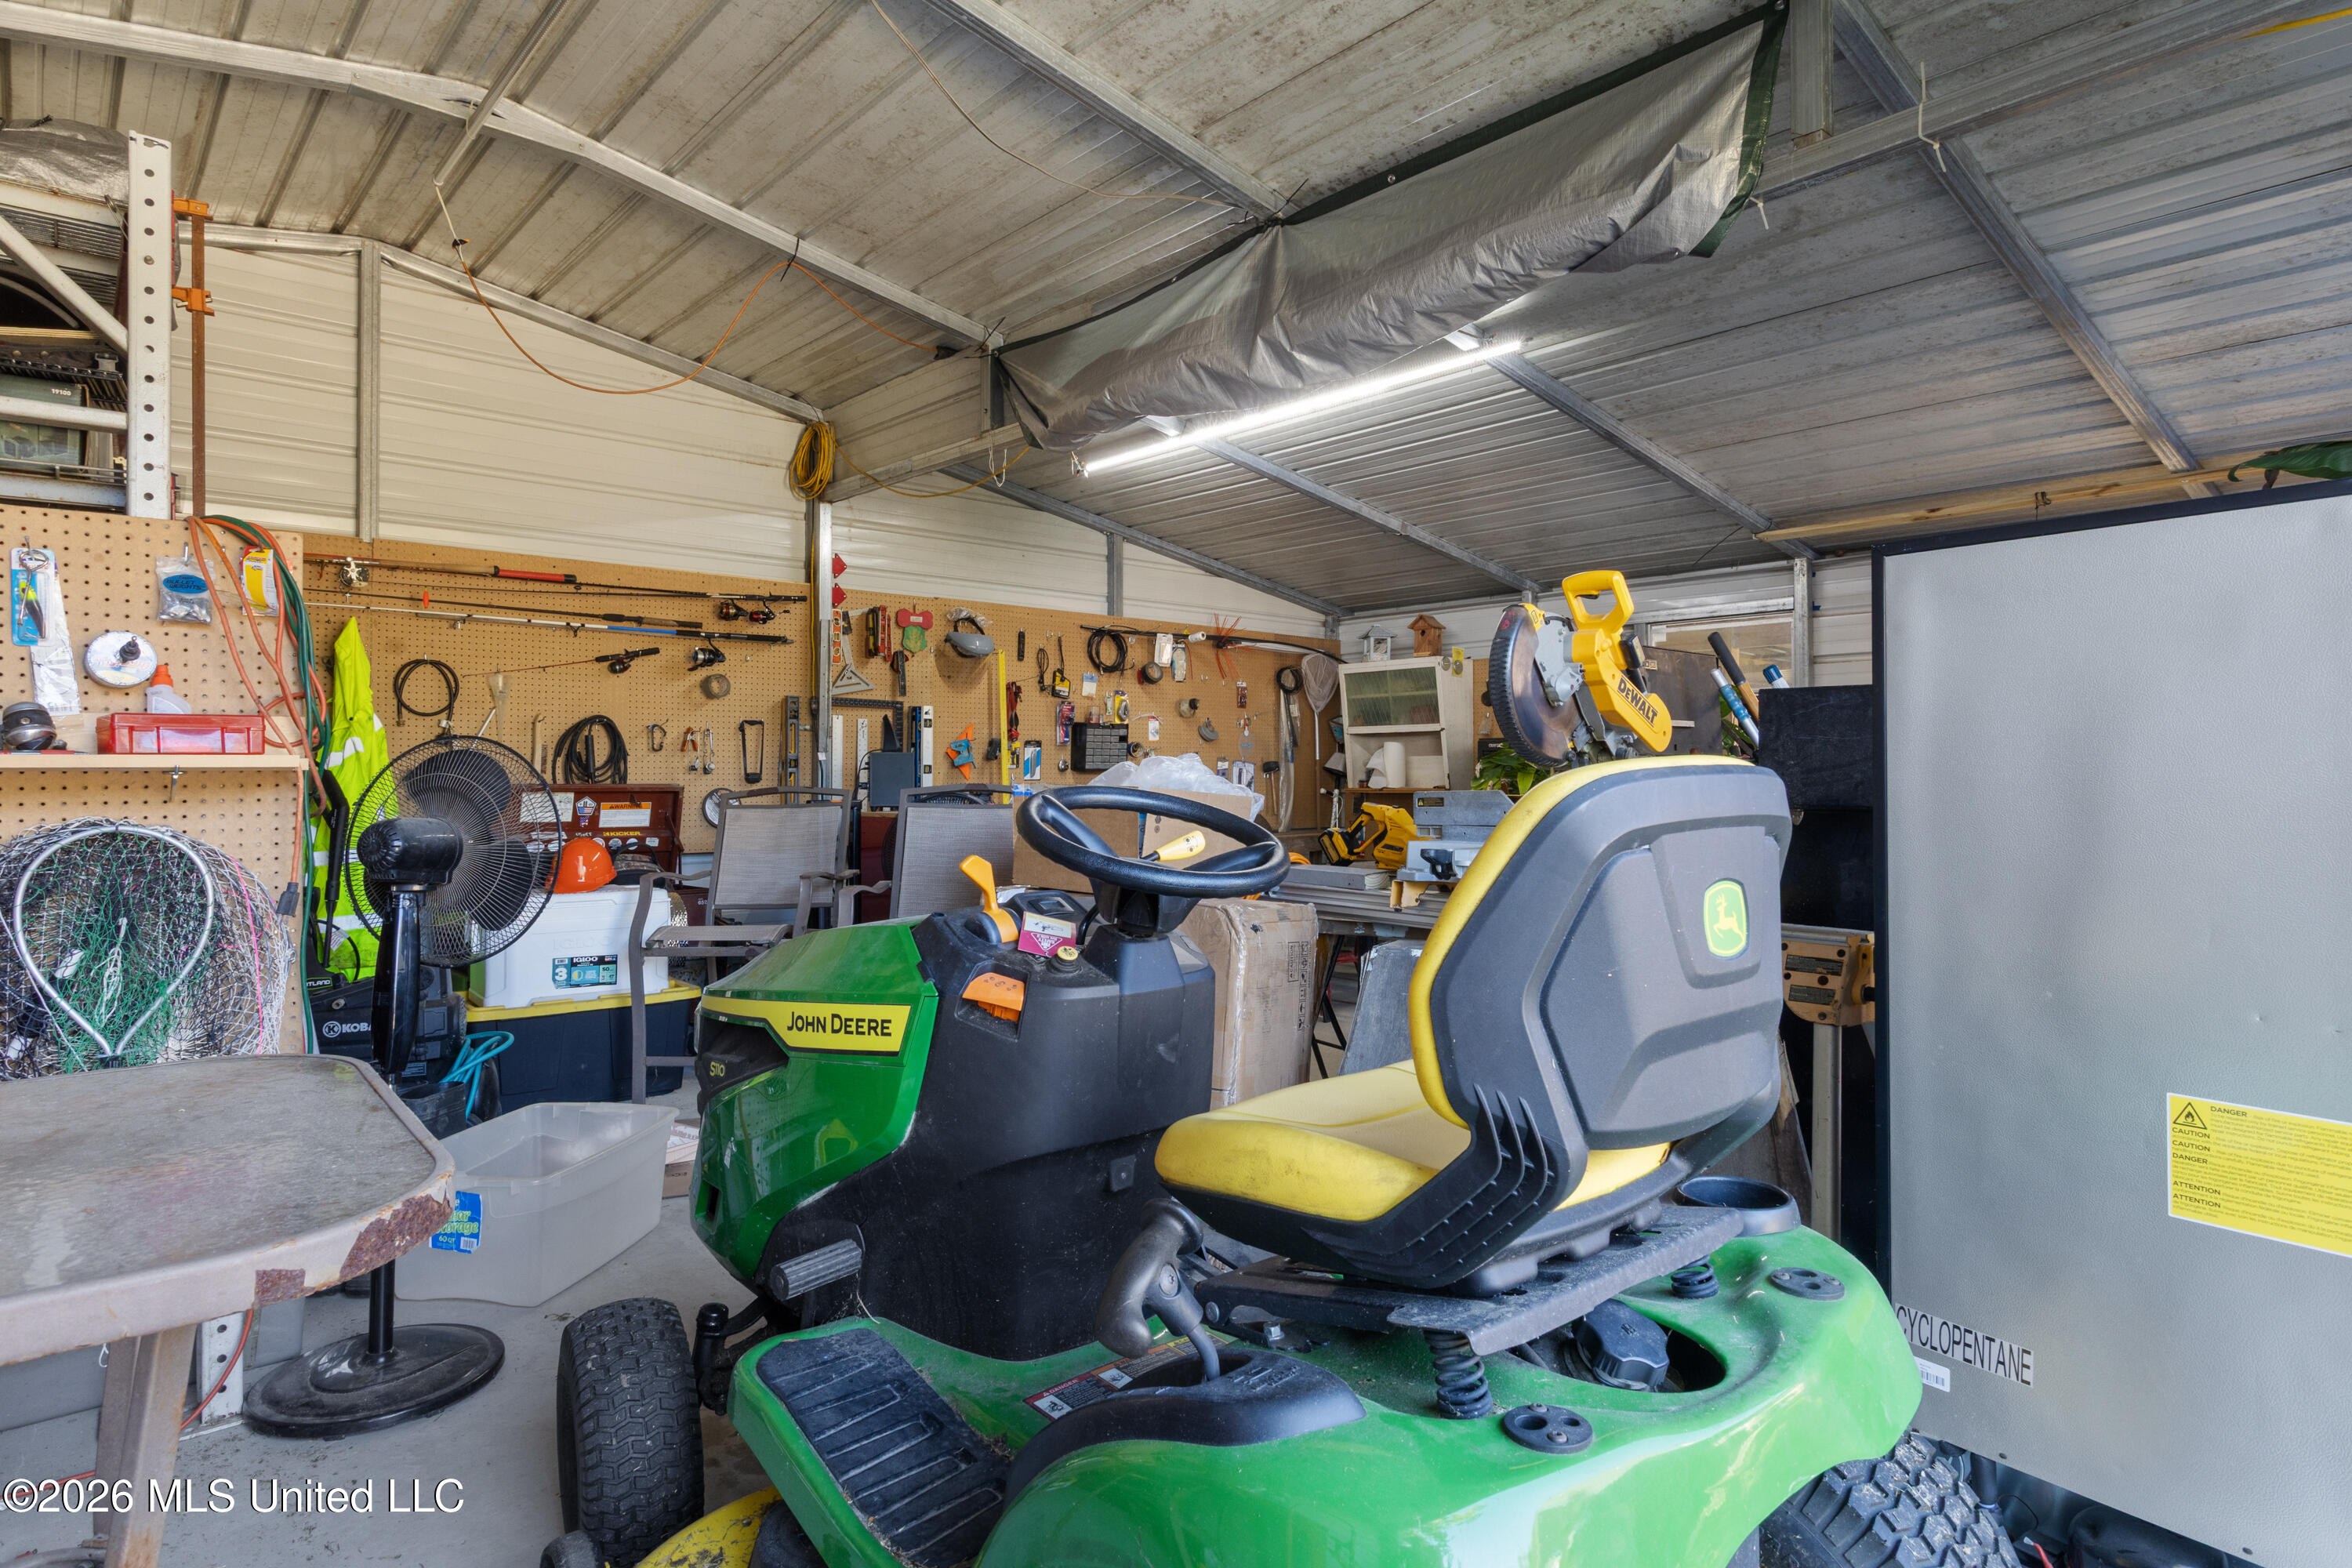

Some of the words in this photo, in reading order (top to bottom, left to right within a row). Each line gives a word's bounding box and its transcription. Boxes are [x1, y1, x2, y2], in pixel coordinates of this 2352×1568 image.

[1617, 677, 1658, 724] DEWALT
[554, 967, 568, 981] 3
[786, 1011, 826, 1034] JOHN
[831, 1013, 892, 1036] DEERE
[710, 1062, 725, 1077] S110
[2210, 1106, 2248, 1117] DANGER
[2172, 1127, 2210, 1139] CAUTION
[2172, 1140, 2210, 1152] CAUTION
[2172, 1152, 2208, 1164] DANGER
[2172, 1180, 2220, 1196] ATTENTION
[2172, 1193, 2220, 1208] ATTENTION
[449, 1210, 472, 1221] ear
[1896, 1305, 2031, 1386] CYCLOPENTANE
[1048, 1379, 1079, 1395] DANGER
